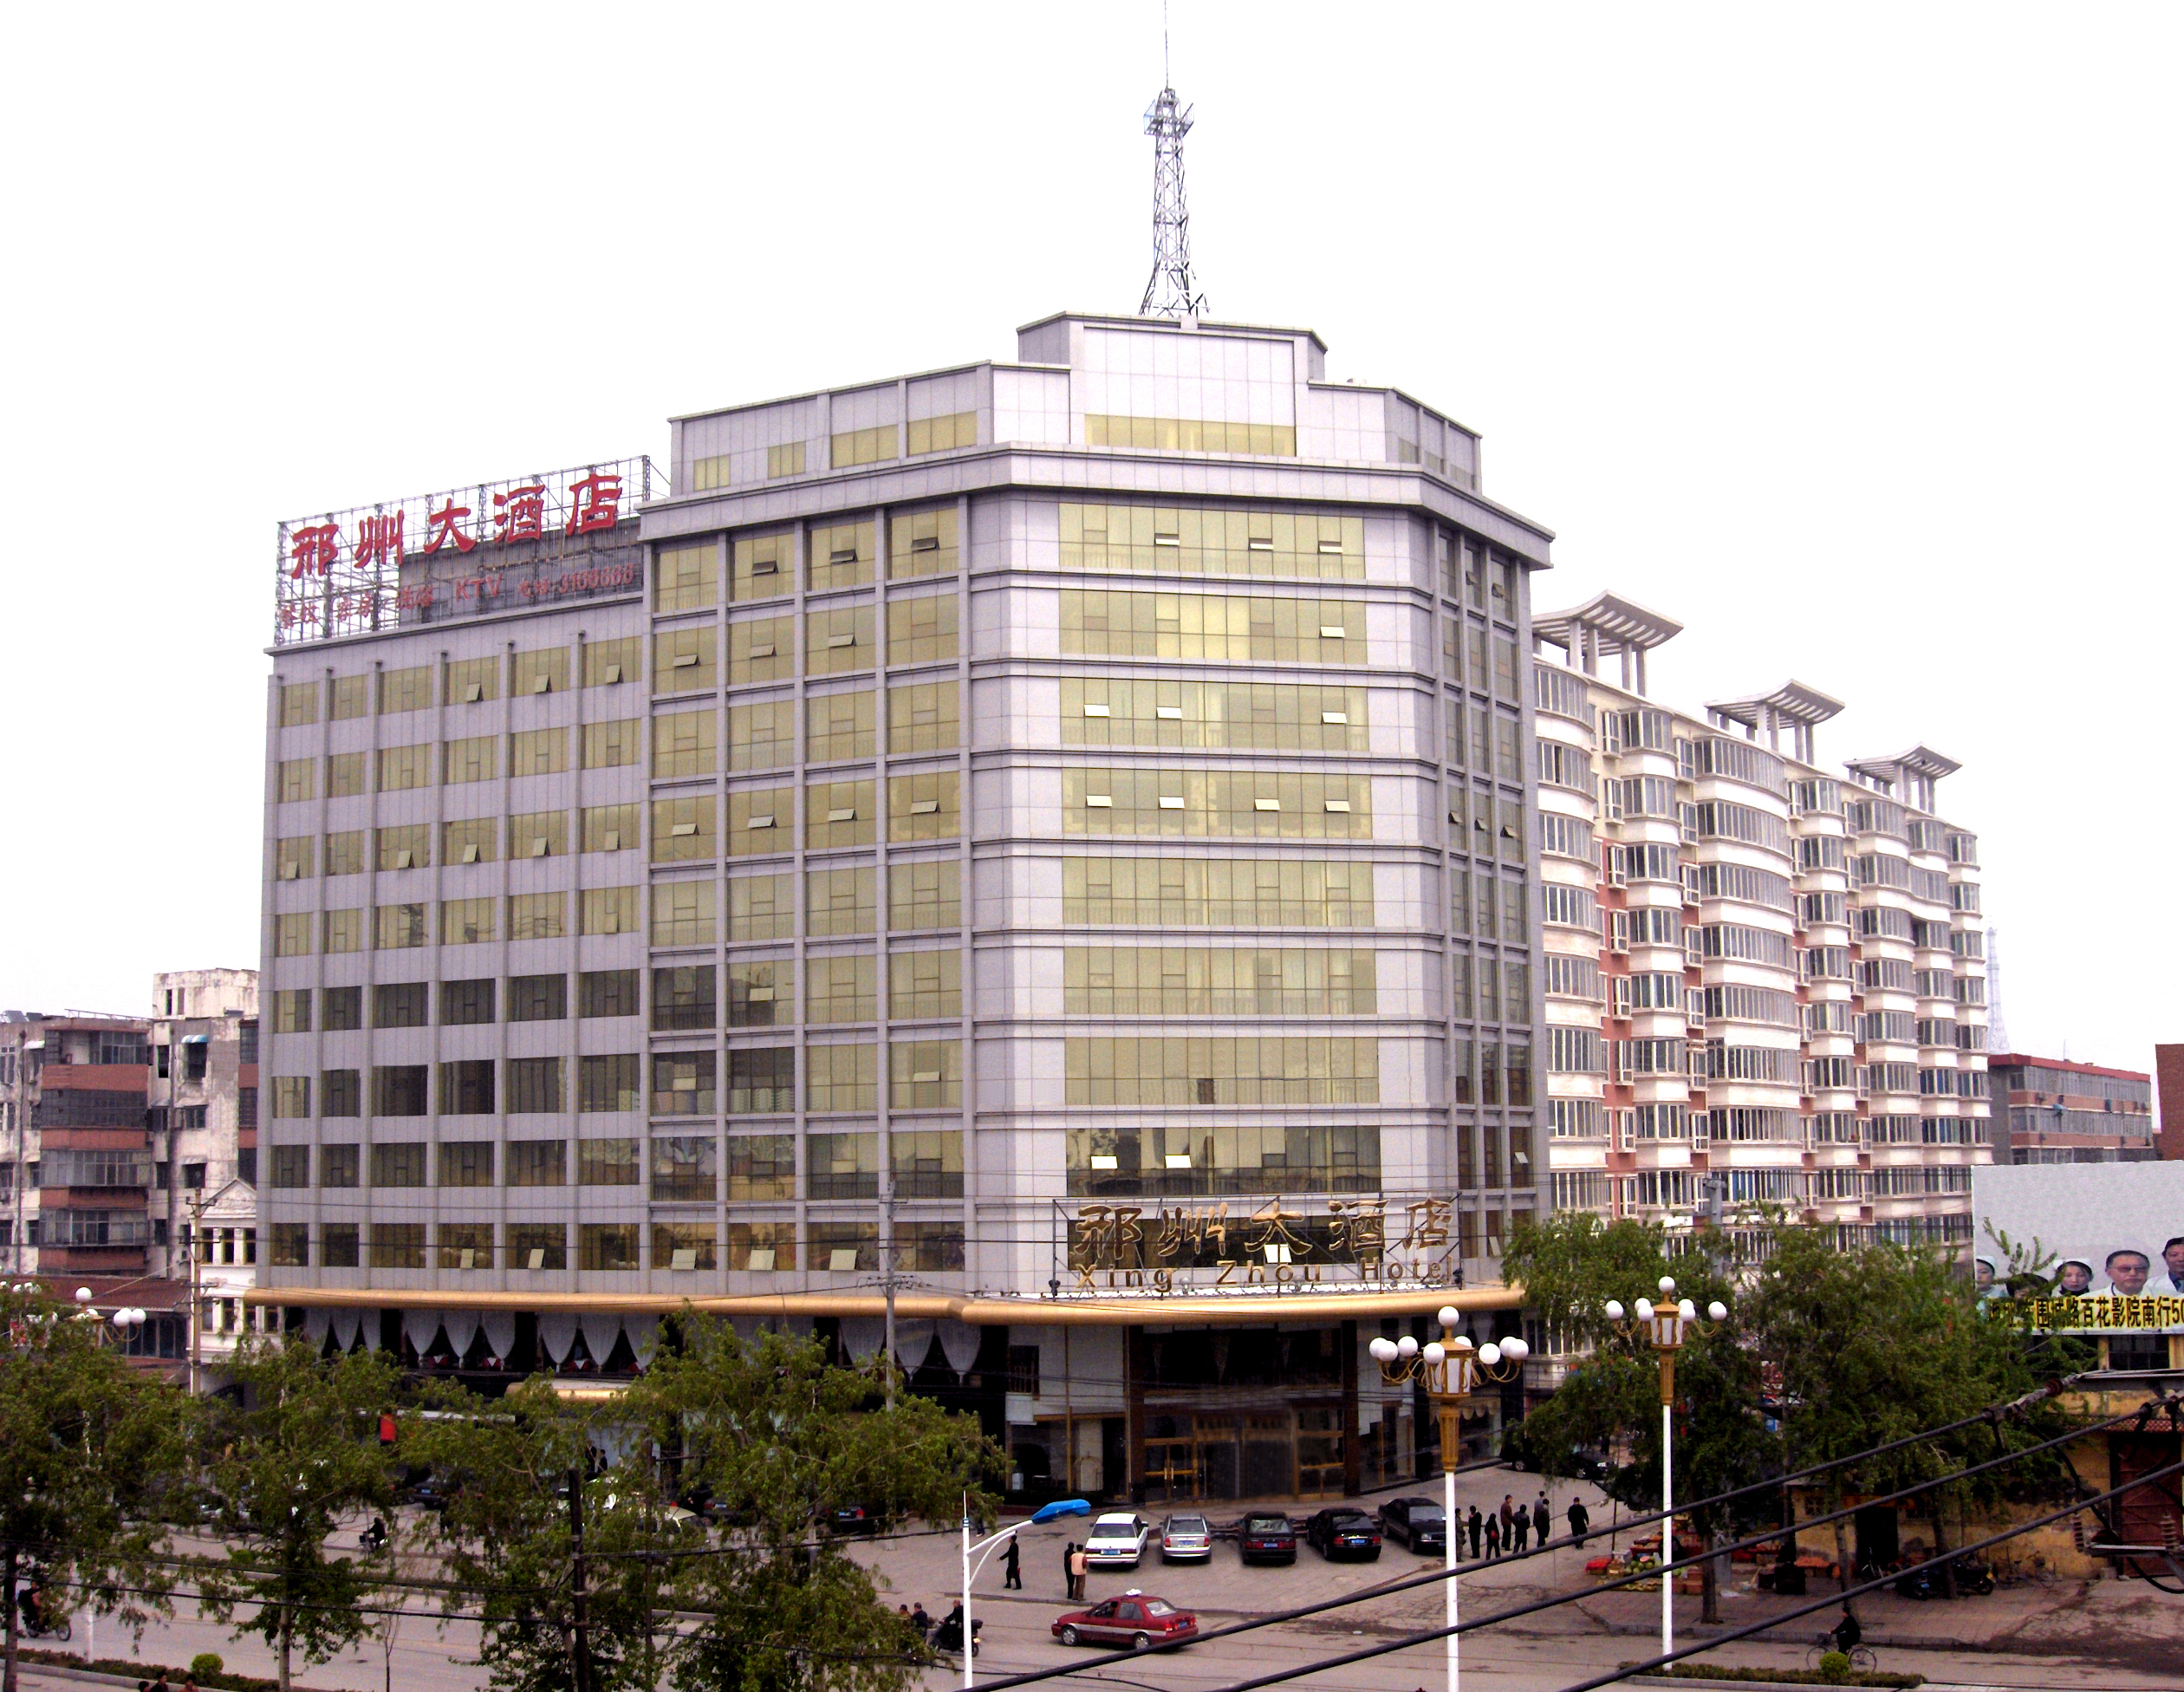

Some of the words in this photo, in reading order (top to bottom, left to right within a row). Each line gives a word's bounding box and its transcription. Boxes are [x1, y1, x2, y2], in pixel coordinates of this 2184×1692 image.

[291, 473, 622, 579] 邢州大酒店
[455, 573, 503, 602] KTV
[1073, 1197, 1453, 1259] 邢州大酒店
[1076, 1263, 1174, 1292] Xing
[1216, 1259, 1321, 1285] Zhou
[1362, 1255, 1452, 1282] Hotel
